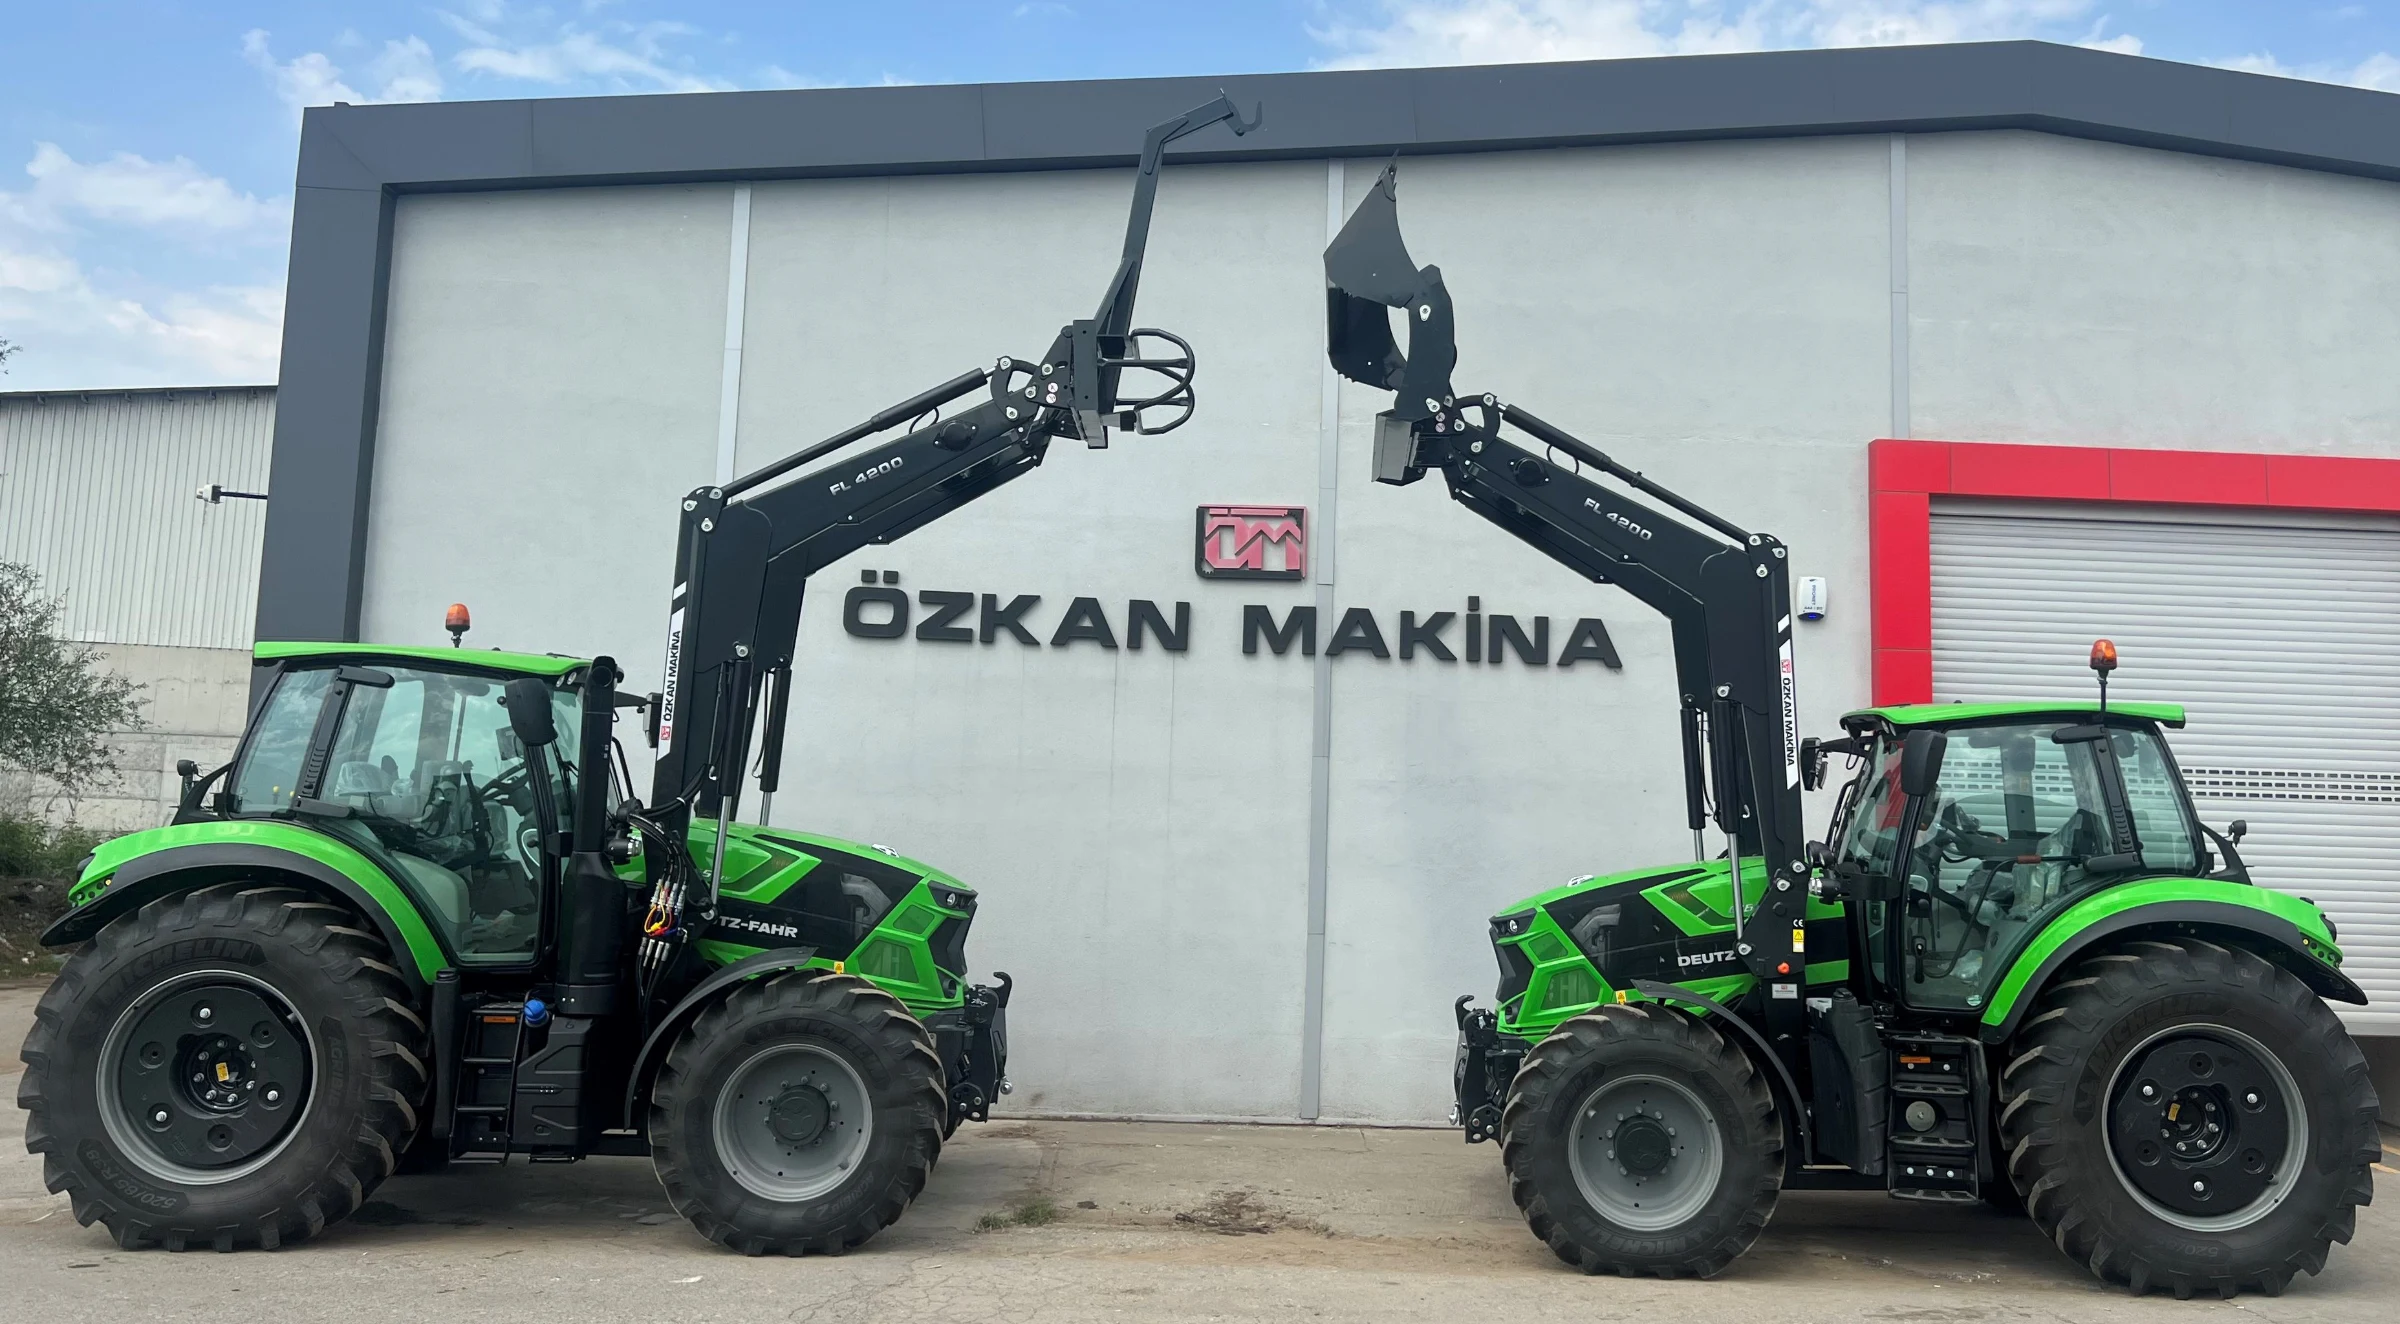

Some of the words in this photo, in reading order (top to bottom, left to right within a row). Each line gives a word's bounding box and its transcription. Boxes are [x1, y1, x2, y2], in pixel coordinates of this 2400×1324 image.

[829, 481, 852, 496] FL
[855, 456, 904, 484] 4200
[1583, 497, 1602, 515] FL
[1606, 512, 1653, 541] 4200
[843, 569, 1190, 652] ÖZKAN
[1242, 596, 1623, 669] MAKİNA
[668, 630, 681, 678] MAKİNA
[663, 680, 676, 722] ÖZKAN
[1782, 677, 1792, 718] ÖZKAN
[1784, 720, 1796, 767] MAKİNA
[719, 915, 798, 938] TZ-FAHR
[1793, 919, 1804, 928] CE
[1677, 950, 1736, 967] DEUTZ
